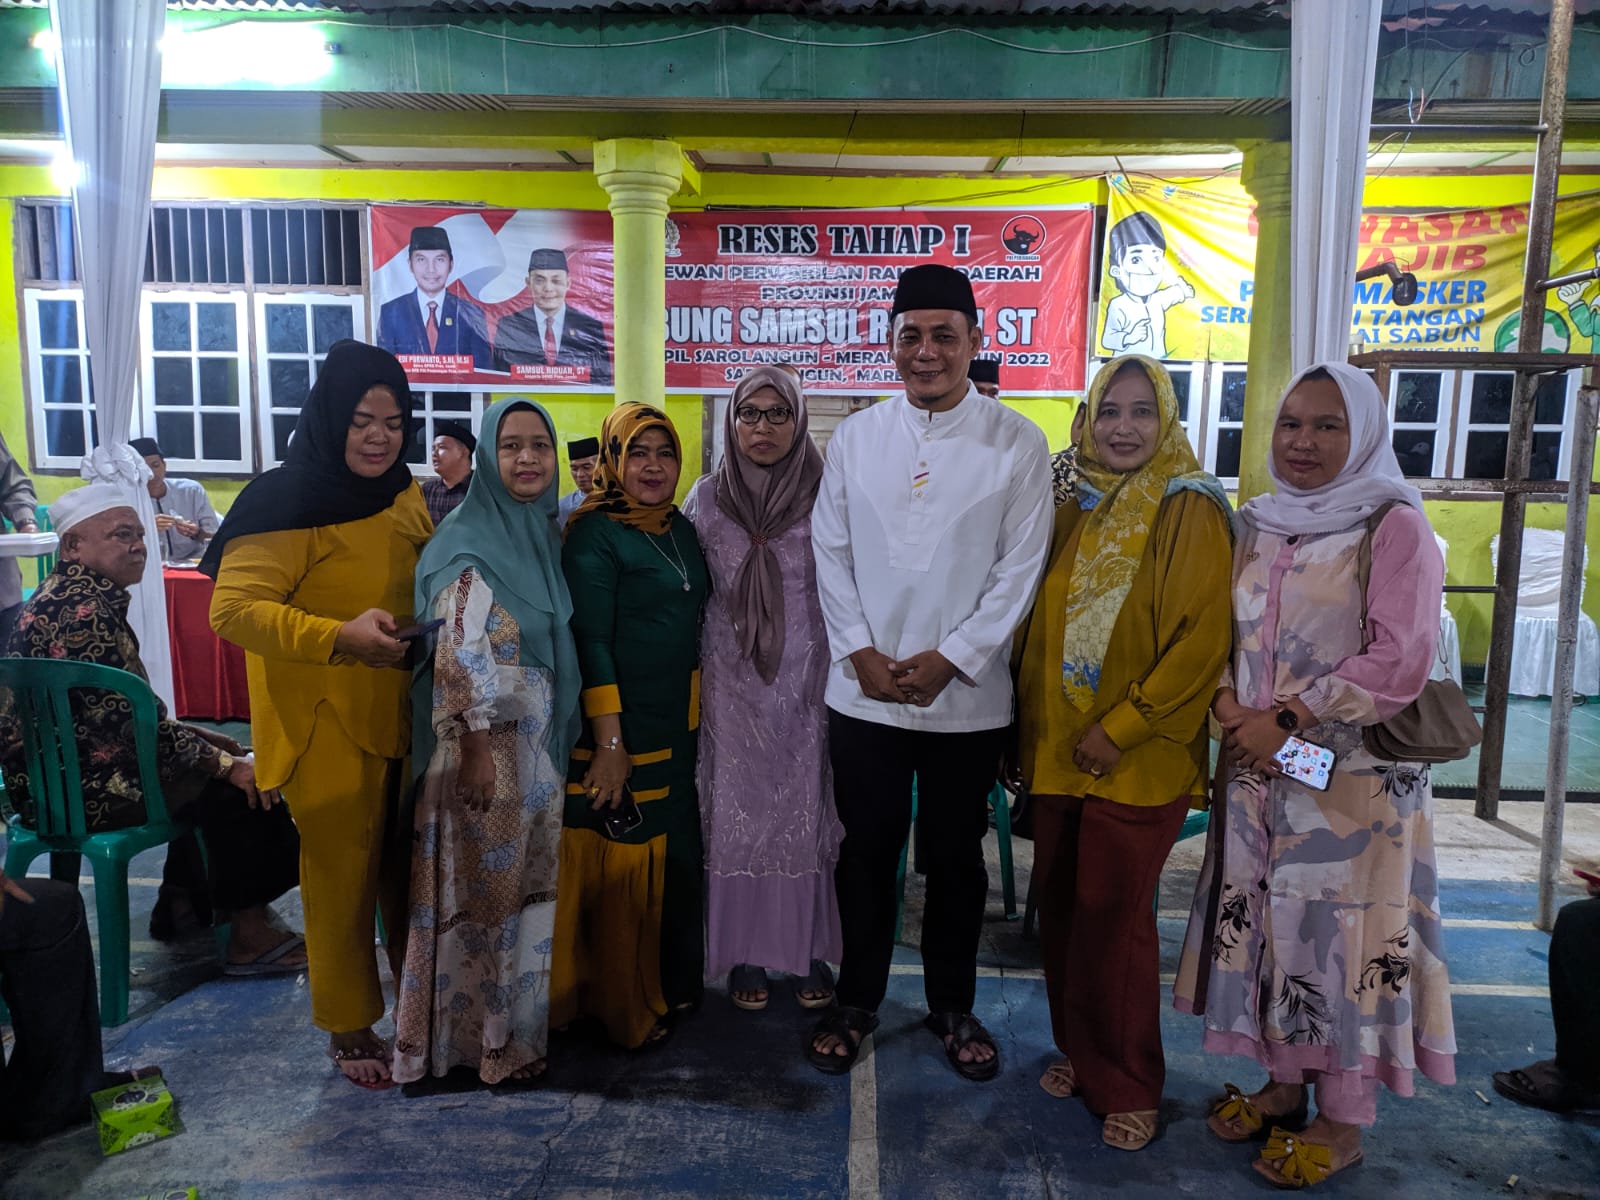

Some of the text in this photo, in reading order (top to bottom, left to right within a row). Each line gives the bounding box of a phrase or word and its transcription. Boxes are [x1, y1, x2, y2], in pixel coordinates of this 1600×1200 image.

[717, 224, 970, 256] RESES TAHAP I
[1360, 245, 1487, 271] AJIB
[665, 264, 724, 281] EWAN
[728, 265, 863, 281] PERWAKILAN
[760, 286, 898, 302] PROVINSI JAM
[1371, 308, 1485, 326] TANGAN
[739, 307, 862, 345] SAMSUL
[996, 307, 1038, 346] ST
[1389, 325, 1480, 343] SABUN
[694, 349, 819, 365] SAROLANGUN
[1006, 352, 1051, 367] 2022
[855, 367, 905, 382] MARE
